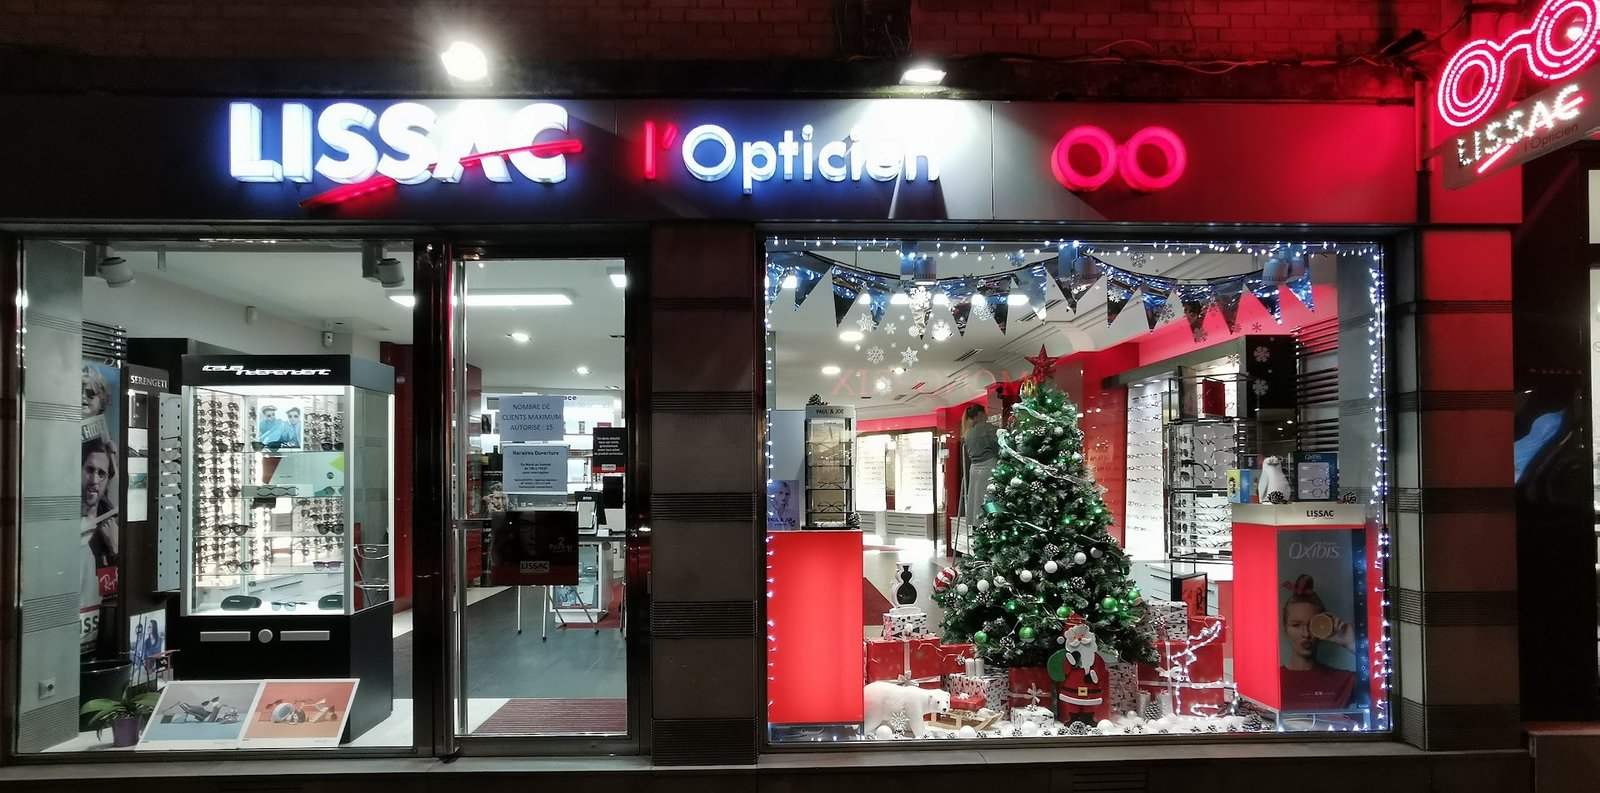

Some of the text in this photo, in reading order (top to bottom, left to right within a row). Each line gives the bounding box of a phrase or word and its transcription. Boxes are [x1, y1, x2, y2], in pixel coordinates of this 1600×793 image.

[1457, 84, 1580, 167] LISSAC
[228, 101, 568, 184] LISSAC
[130, 375, 168, 389] SERENGETI
[1306, 510, 1335, 518] LISSAC
[521, 562, 549, 570] LISSAC
